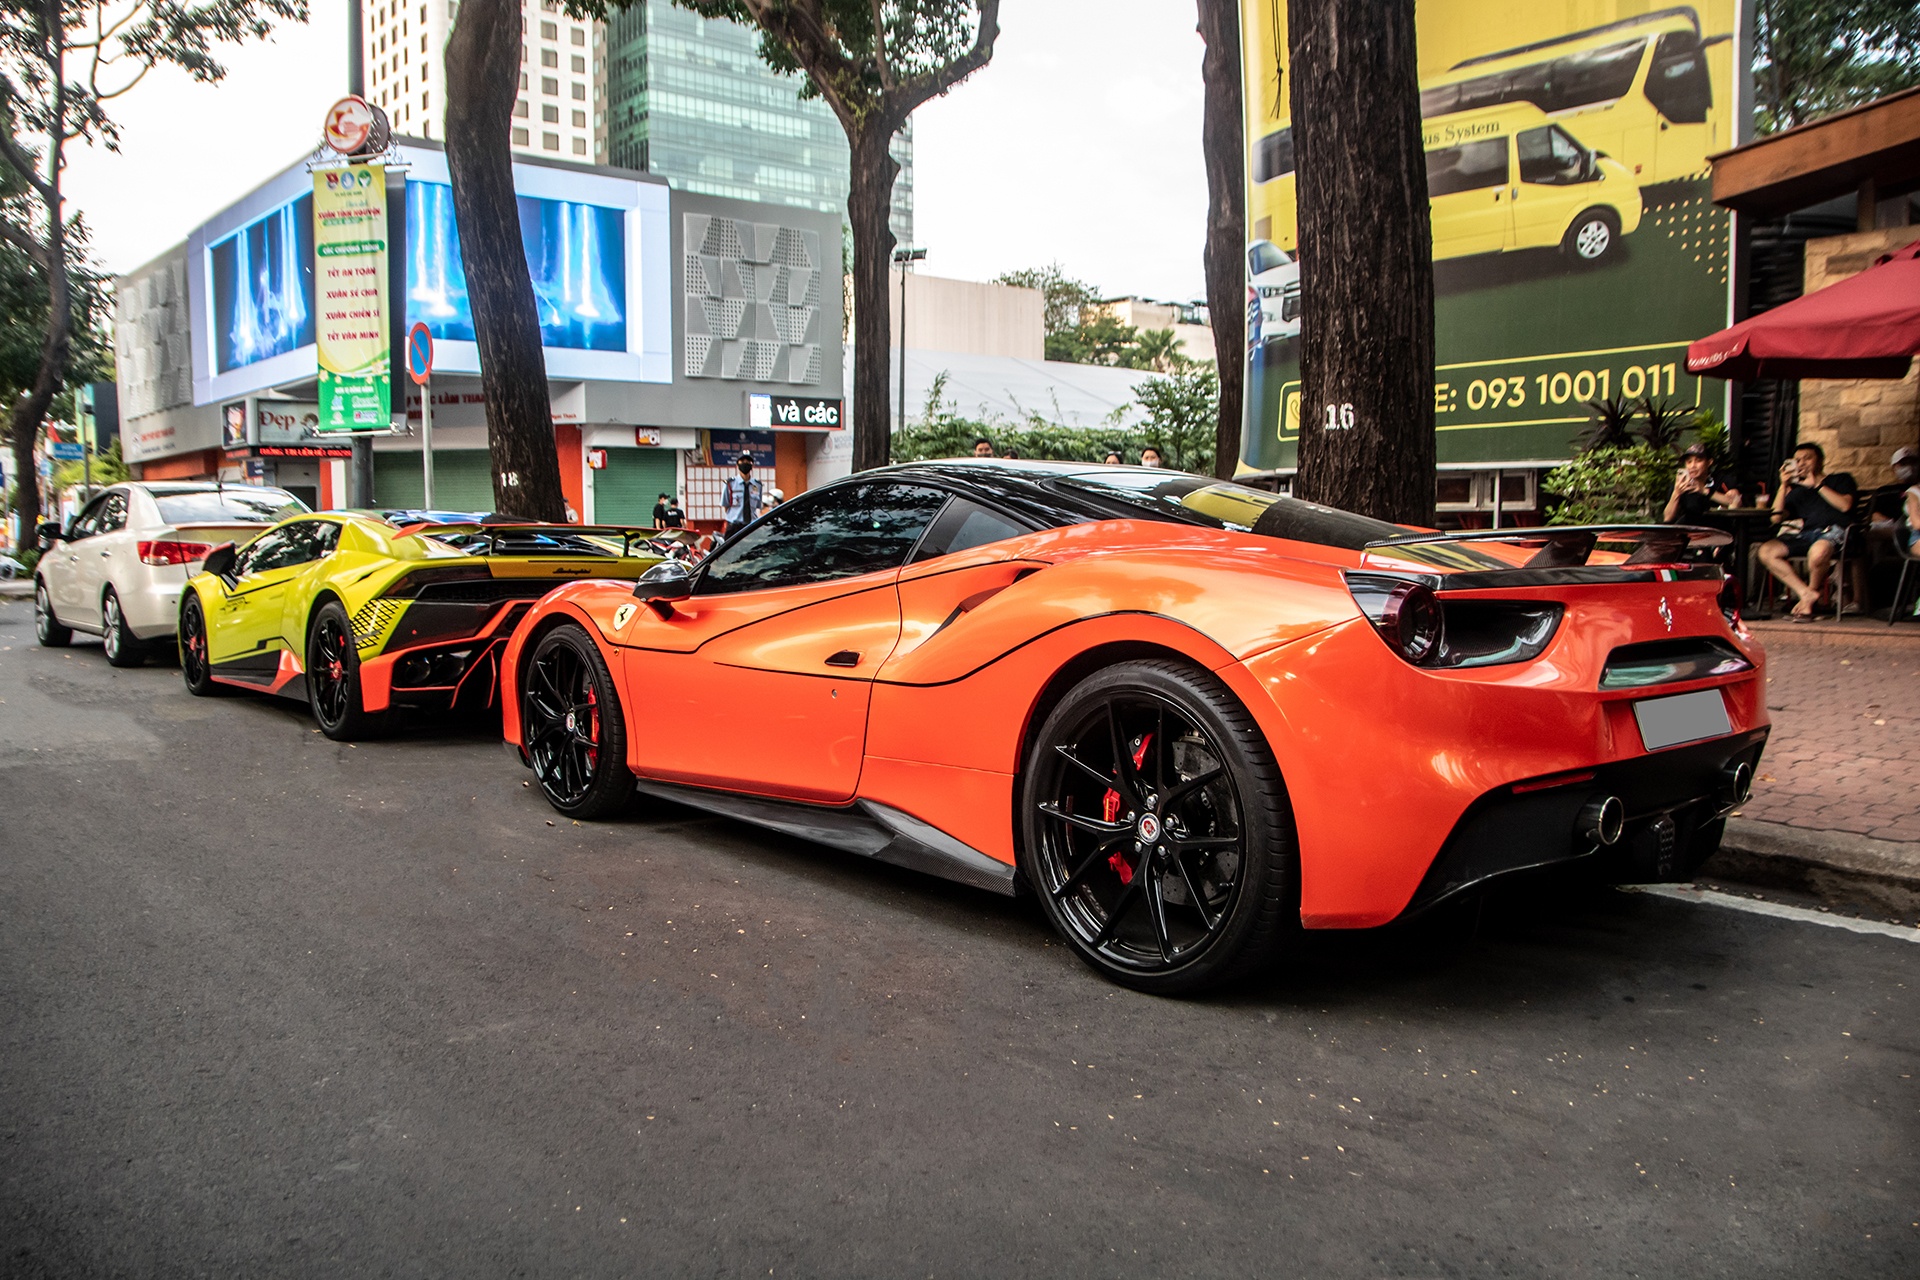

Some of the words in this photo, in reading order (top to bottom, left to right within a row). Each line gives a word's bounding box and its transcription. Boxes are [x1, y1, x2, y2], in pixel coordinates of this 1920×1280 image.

[1423, 132, 1440, 145] us
[1445, 121, 1500, 146] System
[327, 266, 339, 278] TẾT
[342, 268, 353, 277] AN
[326, 288, 348, 299] XUÂN
[326, 310, 347, 320] XUÂN
[327, 330, 339, 341] TẾT
[359, 330, 379, 340] MINH
[1434, 382, 1457, 414] E:
[1466, 376, 1526, 411] 093
[1536, 368, 1611, 405] 1001
[1622, 362, 1677, 400] 011
[438, 391, 459, 405] LÀM
[777, 400, 800, 422] và
[804, 401, 838, 424] các
[1325, 403, 1355, 431] 16
[259, 411, 296, 431] Đẹp
